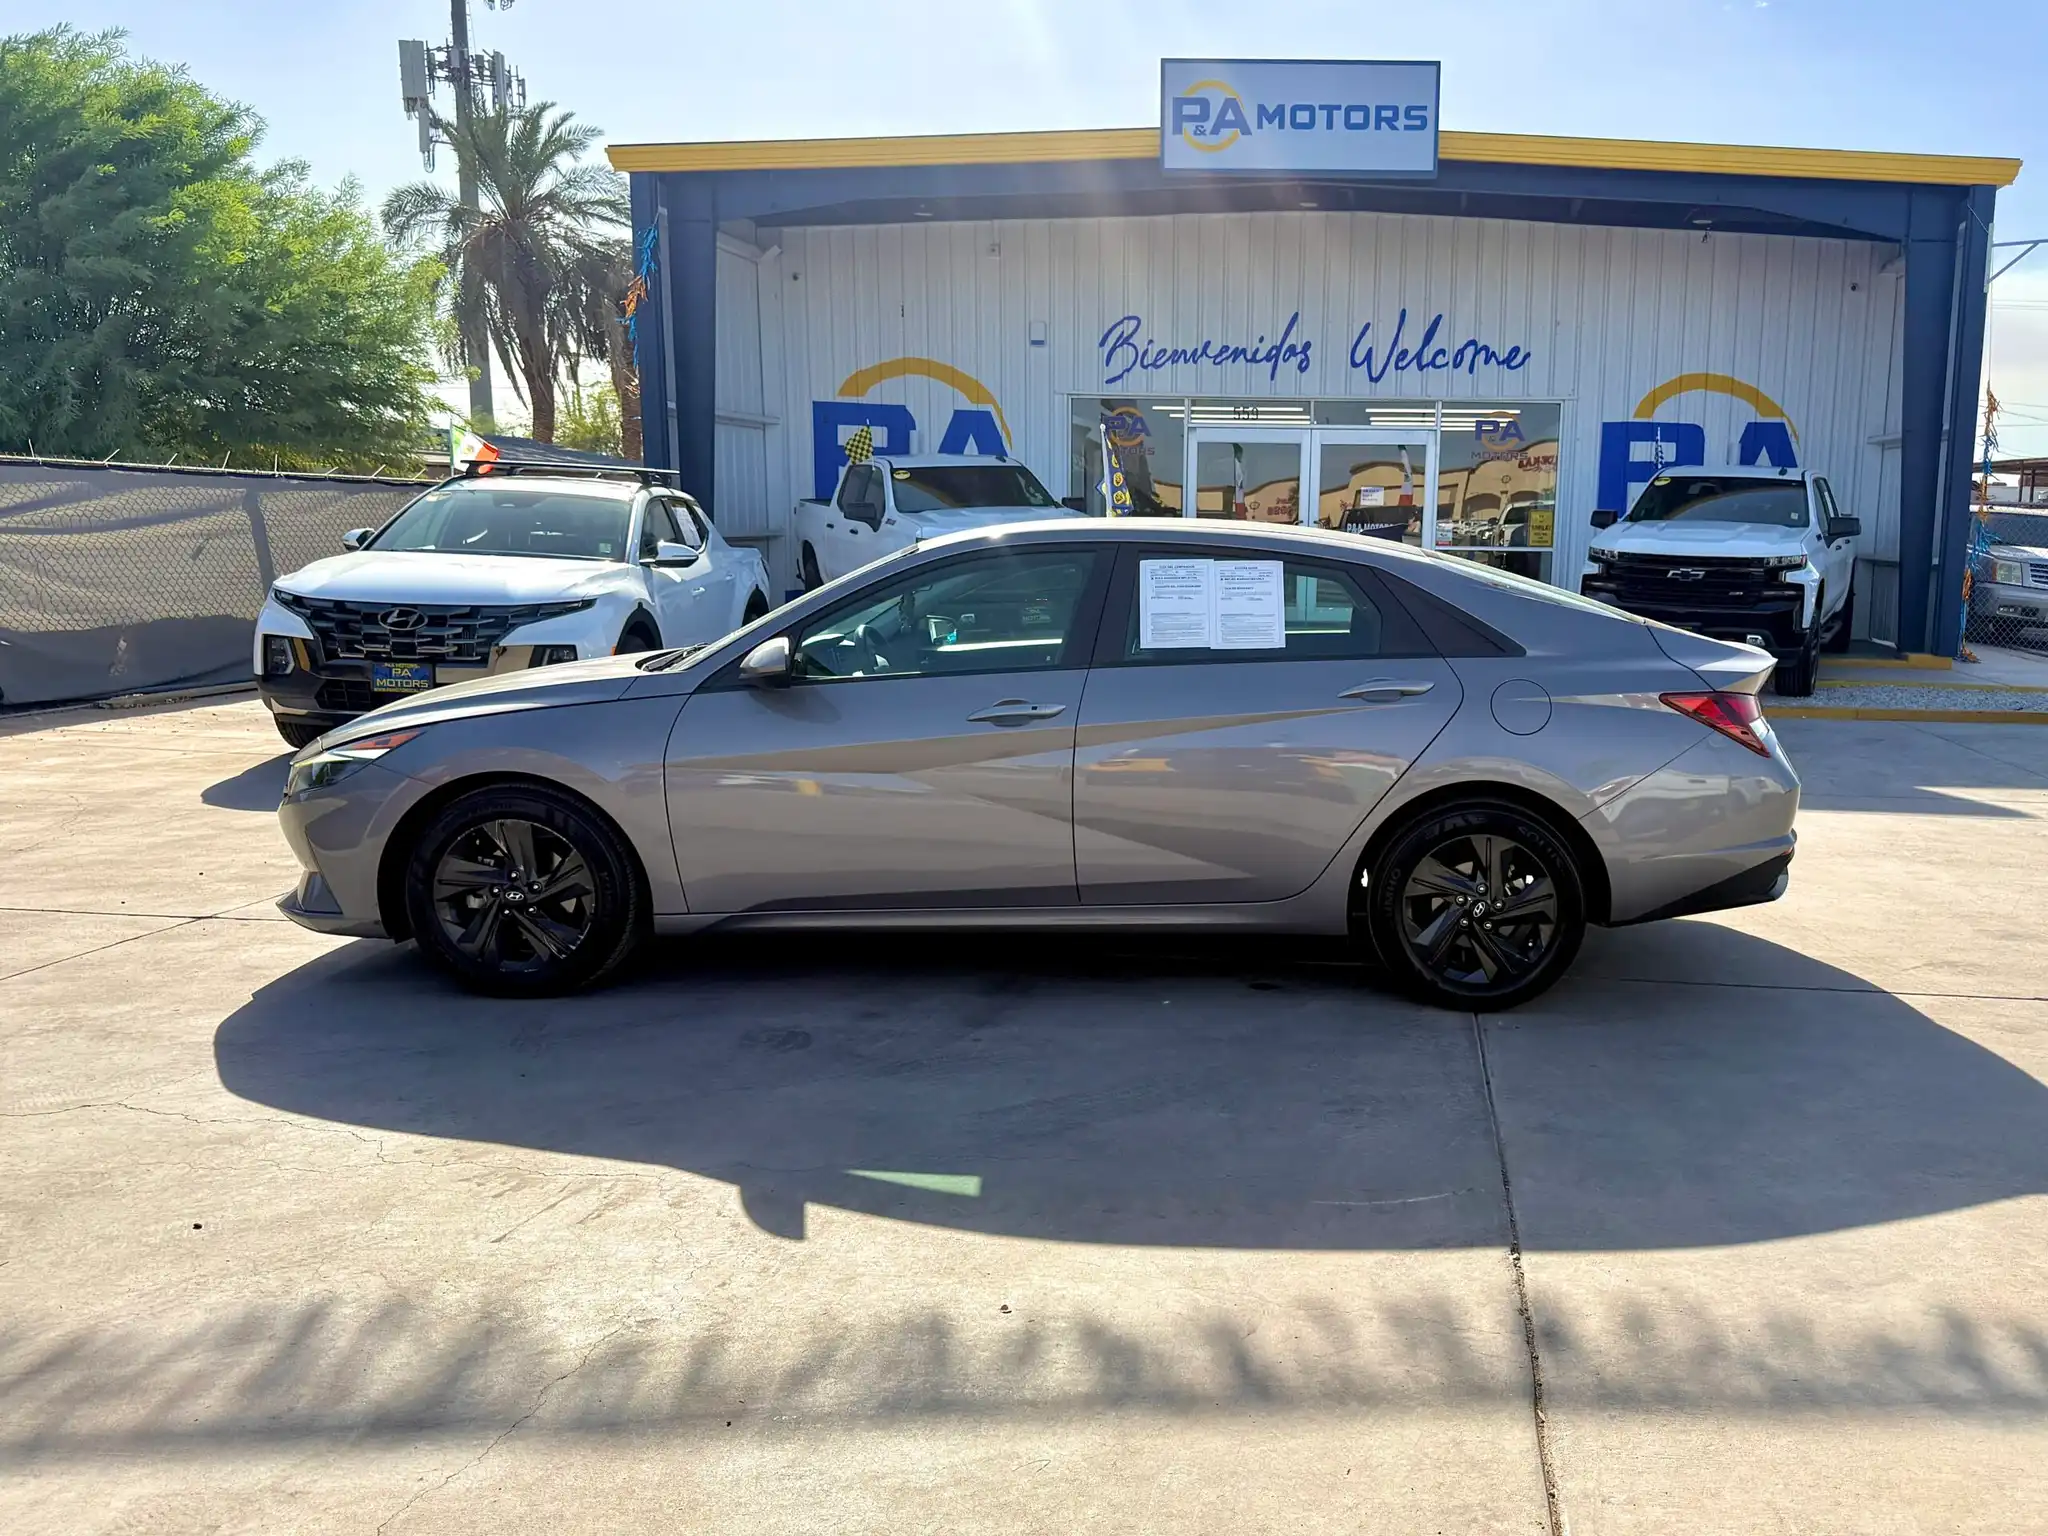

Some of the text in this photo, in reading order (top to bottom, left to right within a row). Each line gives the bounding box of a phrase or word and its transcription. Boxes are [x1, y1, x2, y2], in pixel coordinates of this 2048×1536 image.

[1257, 104, 1428, 131] MOTORS
[1099, 308, 1532, 384] Bienvenidos Welcome
[1233, 406, 1259, 420] 559
[376, 678, 428, 687] MOTORS
